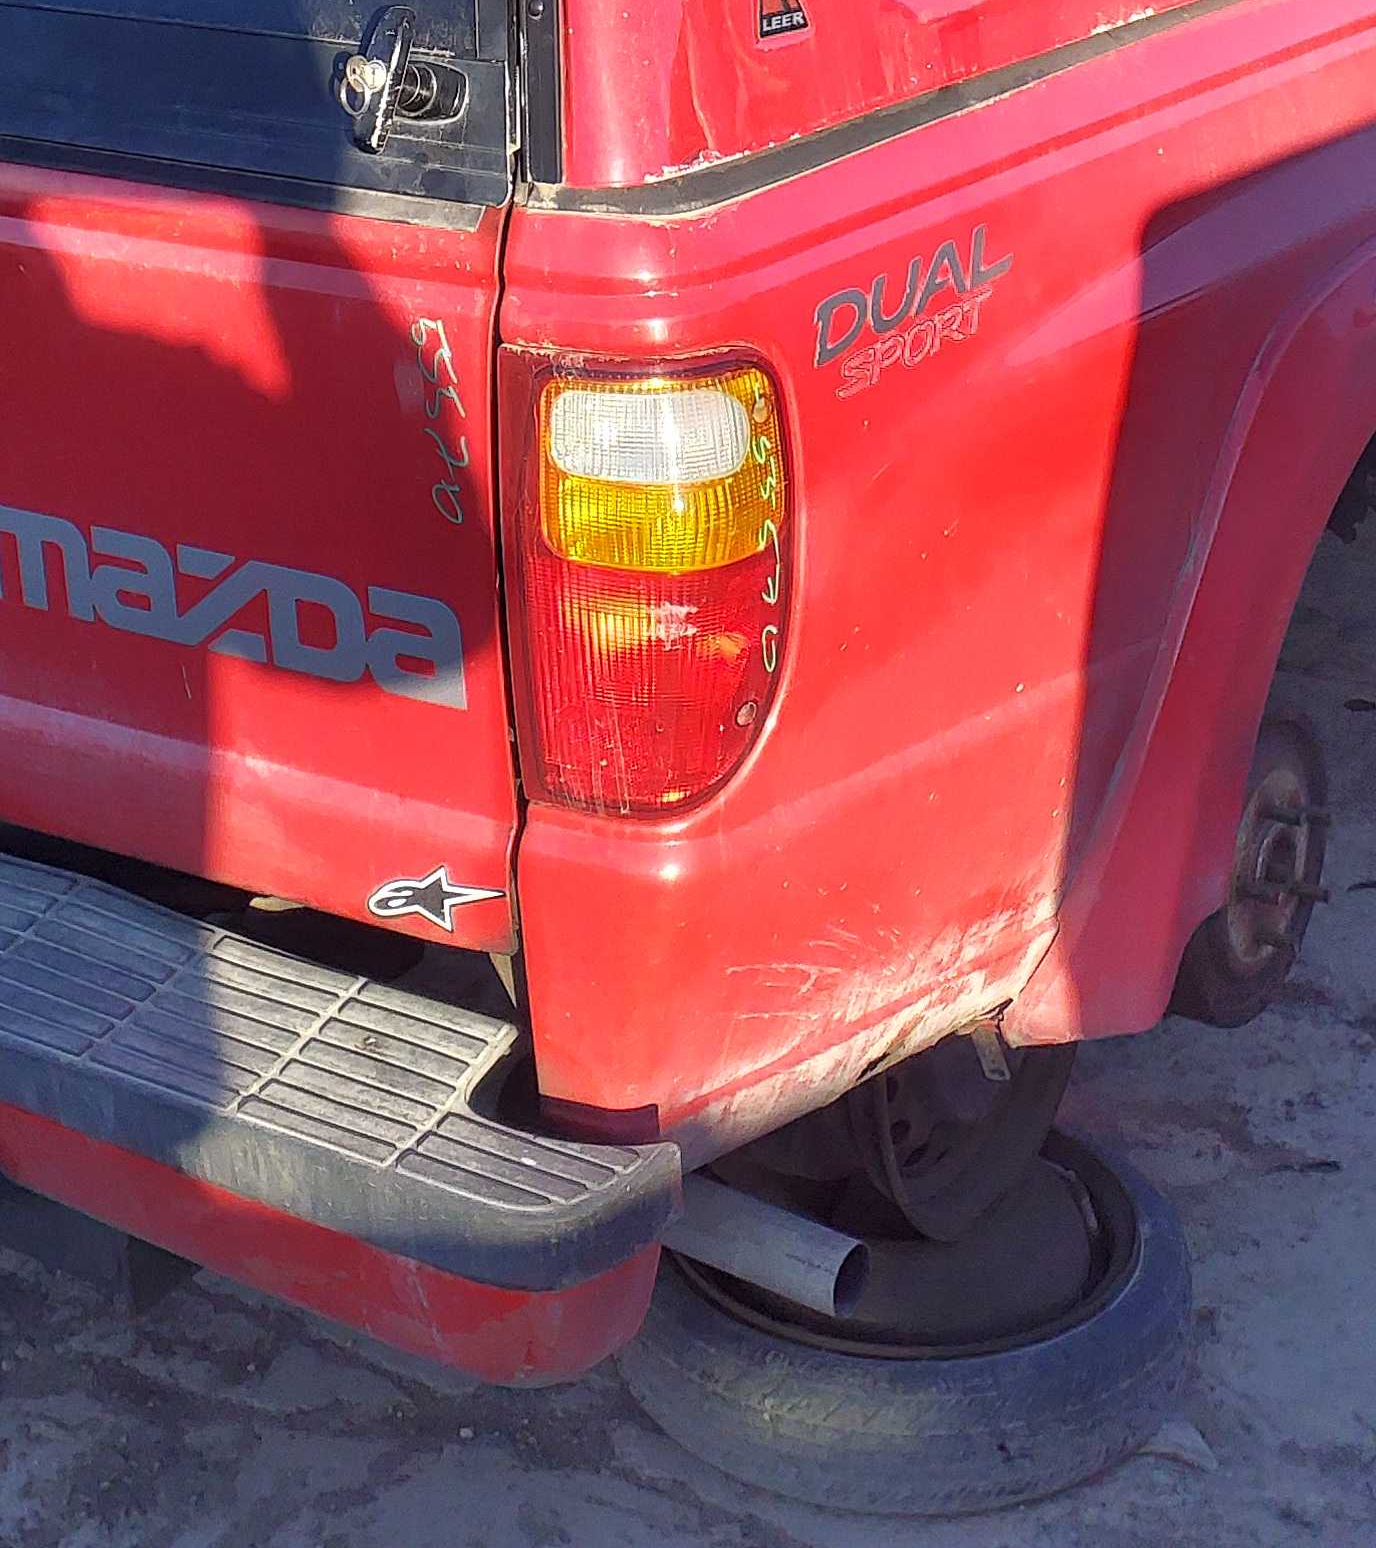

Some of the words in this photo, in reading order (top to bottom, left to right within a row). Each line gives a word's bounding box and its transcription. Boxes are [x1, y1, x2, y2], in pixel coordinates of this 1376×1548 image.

[762, 11, 805, 32] LEER
[814, 223, 1014, 368] DUAL
[835, 288, 993, 399] SPORT
